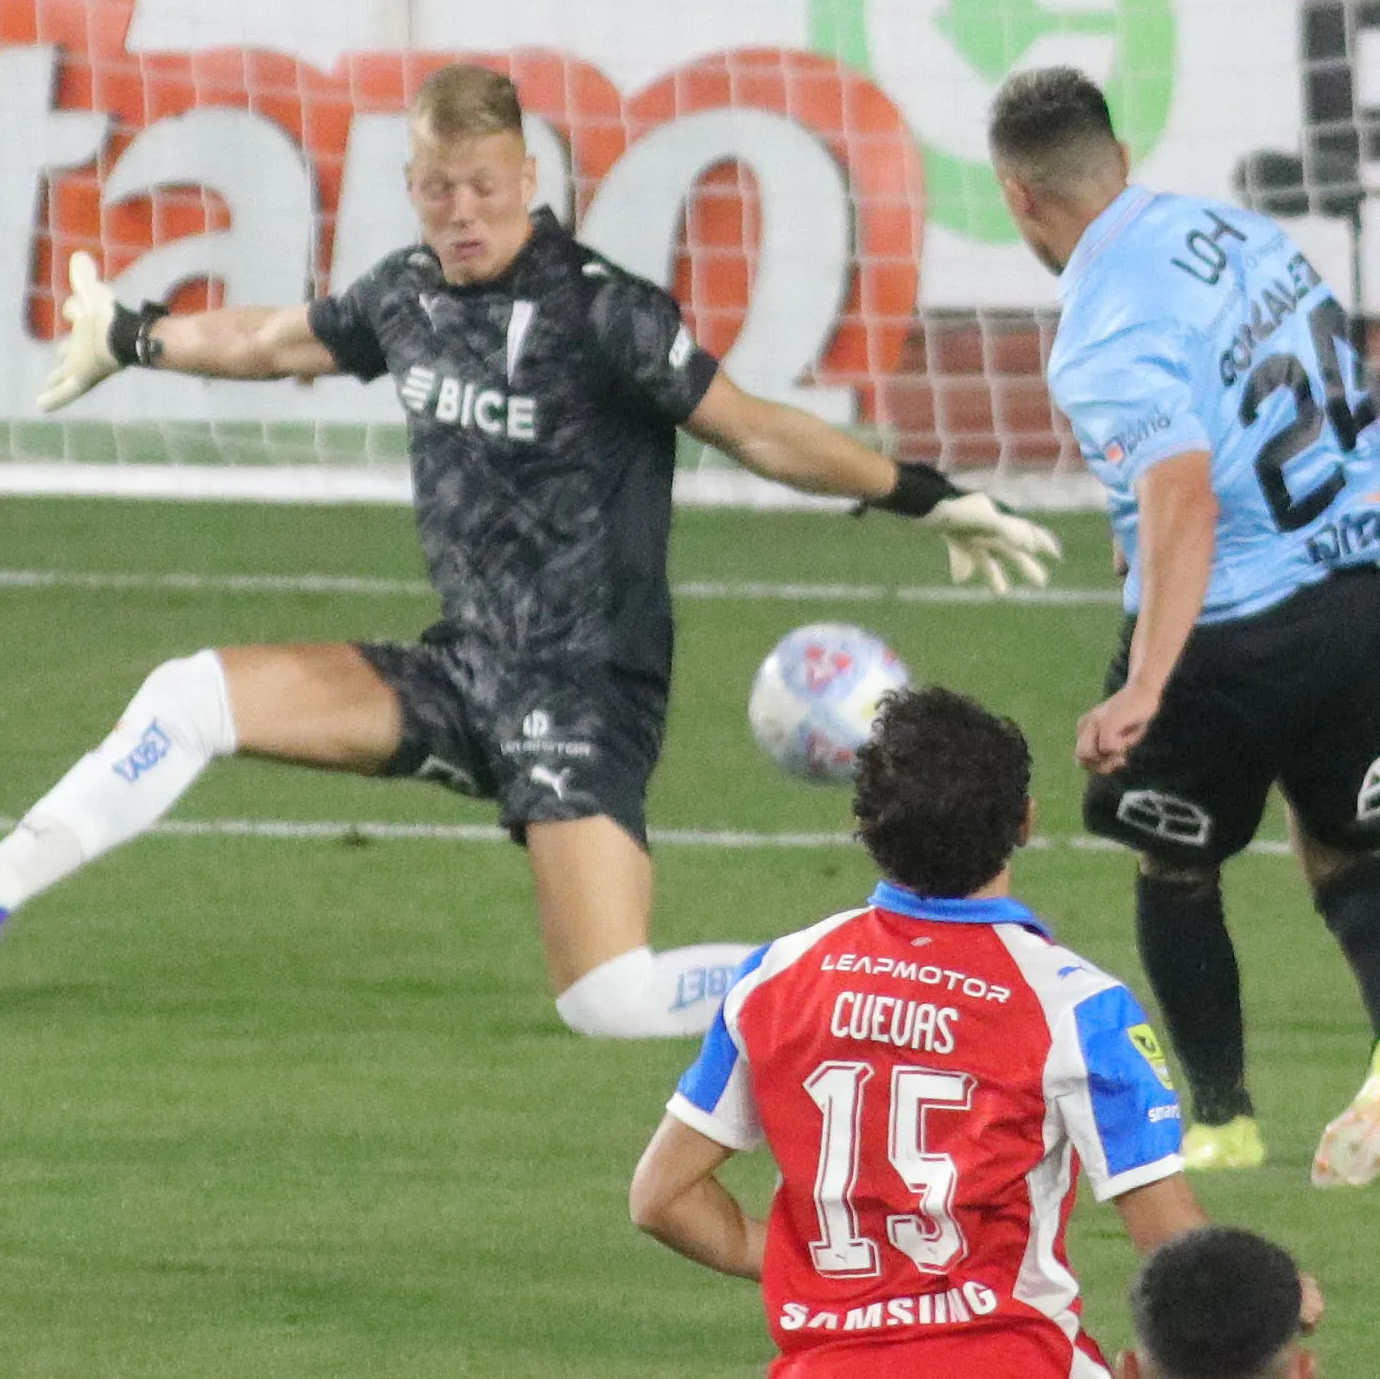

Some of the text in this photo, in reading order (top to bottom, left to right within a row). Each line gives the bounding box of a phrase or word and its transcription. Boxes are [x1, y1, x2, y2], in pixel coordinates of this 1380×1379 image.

[435, 375, 538, 441] BICE
[820, 953, 1012, 1004] LEAPMOTOR
[829, 990, 960, 1055] CUEVAS
[802, 1059, 978, 1279] 15
